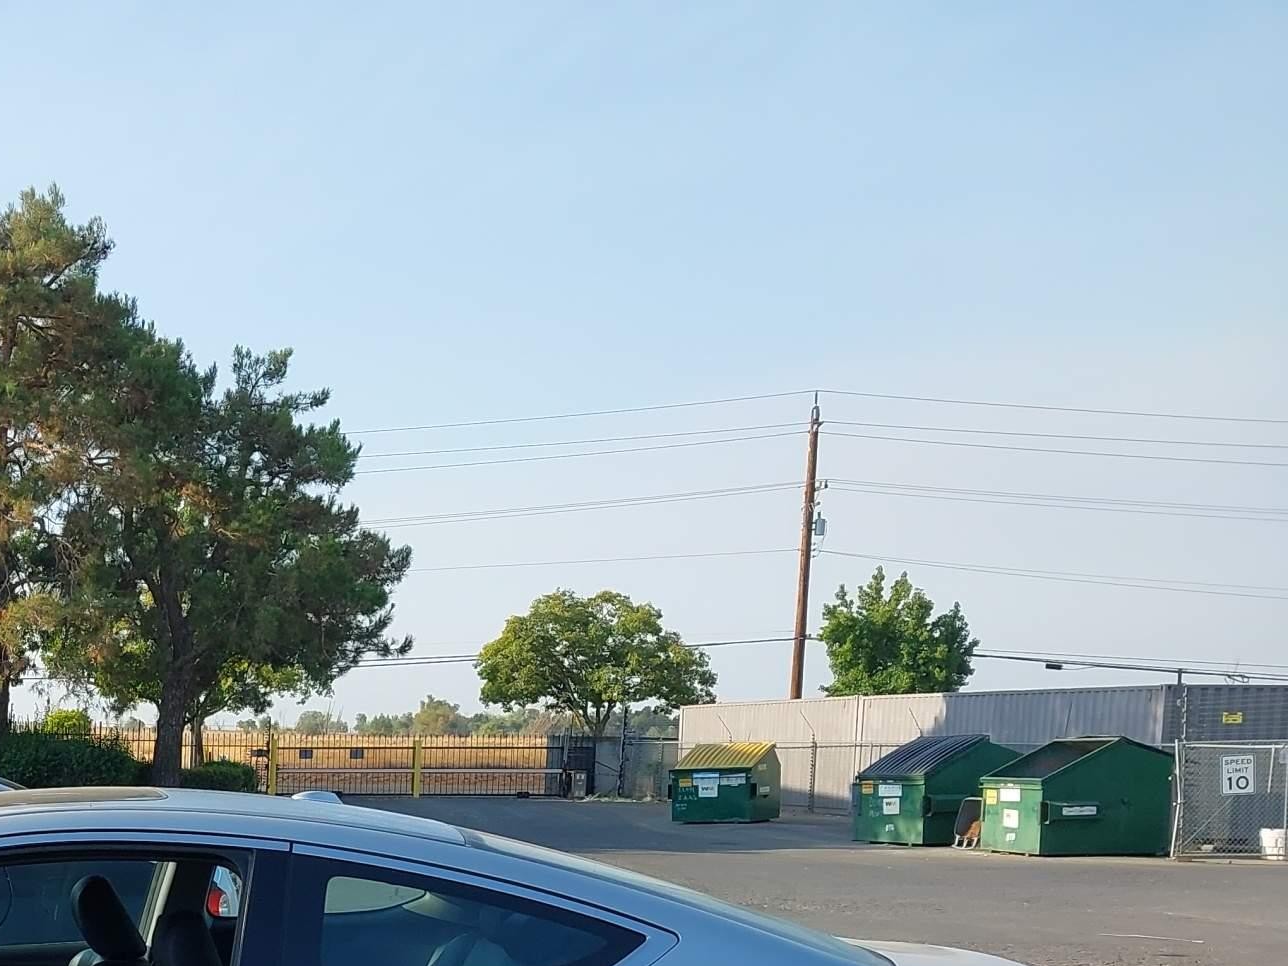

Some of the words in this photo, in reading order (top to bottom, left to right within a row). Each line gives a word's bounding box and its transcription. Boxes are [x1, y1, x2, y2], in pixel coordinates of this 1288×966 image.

[1224, 758, 1252, 766] SPEED
[1226, 766, 1249, 774] LIMIT
[1227, 775, 1249, 791] 10
